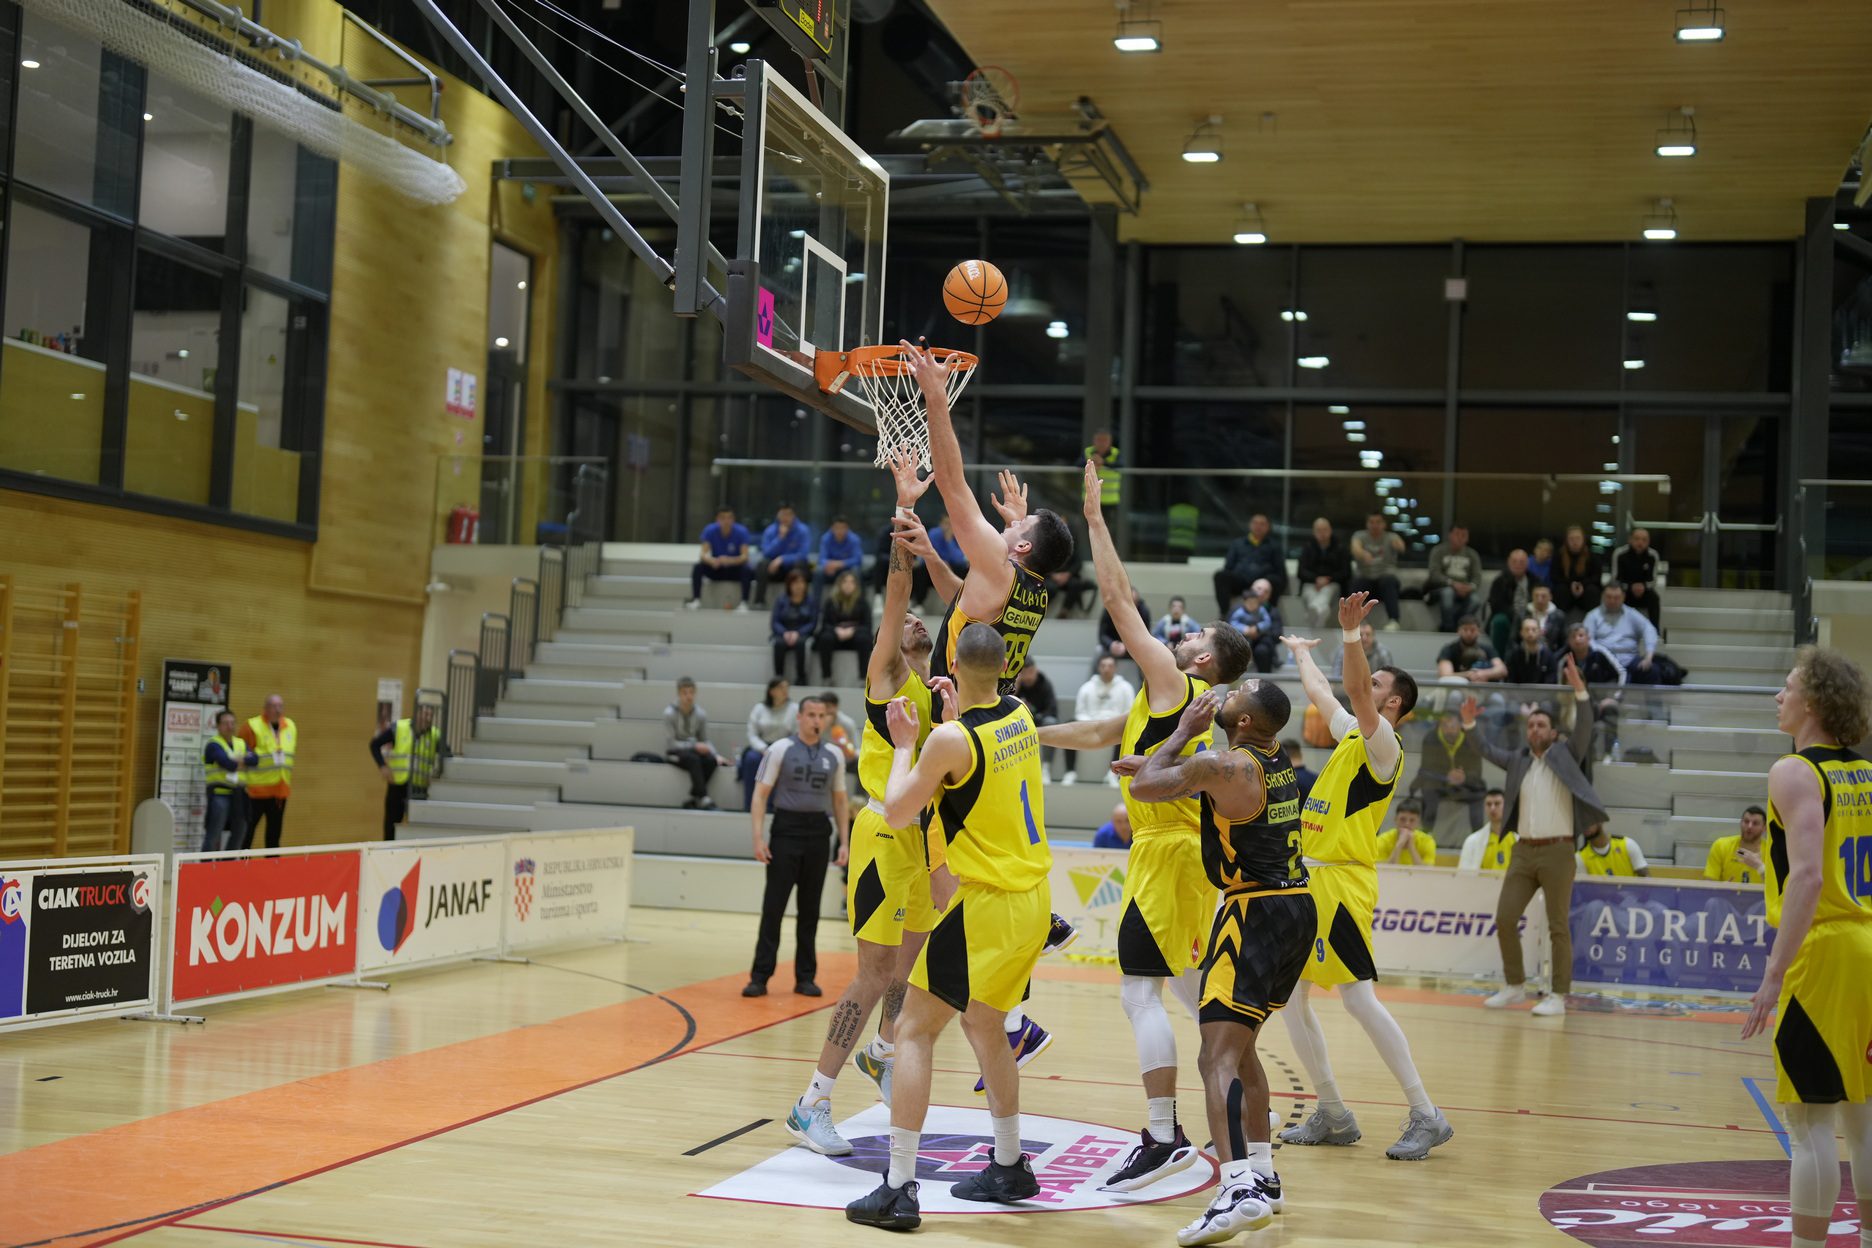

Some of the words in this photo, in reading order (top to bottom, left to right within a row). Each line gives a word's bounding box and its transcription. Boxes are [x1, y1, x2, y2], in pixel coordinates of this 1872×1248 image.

[1020, 779, 1041, 845] 1
[1287, 830, 1302, 880] 2
[38, 884, 126, 910] CIAKTRUCK
[425, 878, 492, 928] JANAF
[62, 933, 109, 949] DIJELOVI
[110, 929, 126, 944] ZA
[189, 891, 348, 967] KONZUM
[49, 953, 96, 971] TERETNA
[98, 948, 137, 966] VOZILA
[1315, 937, 1325, 962] 9
[65, 987, 119, 1002] www.ciak-truck.hr
